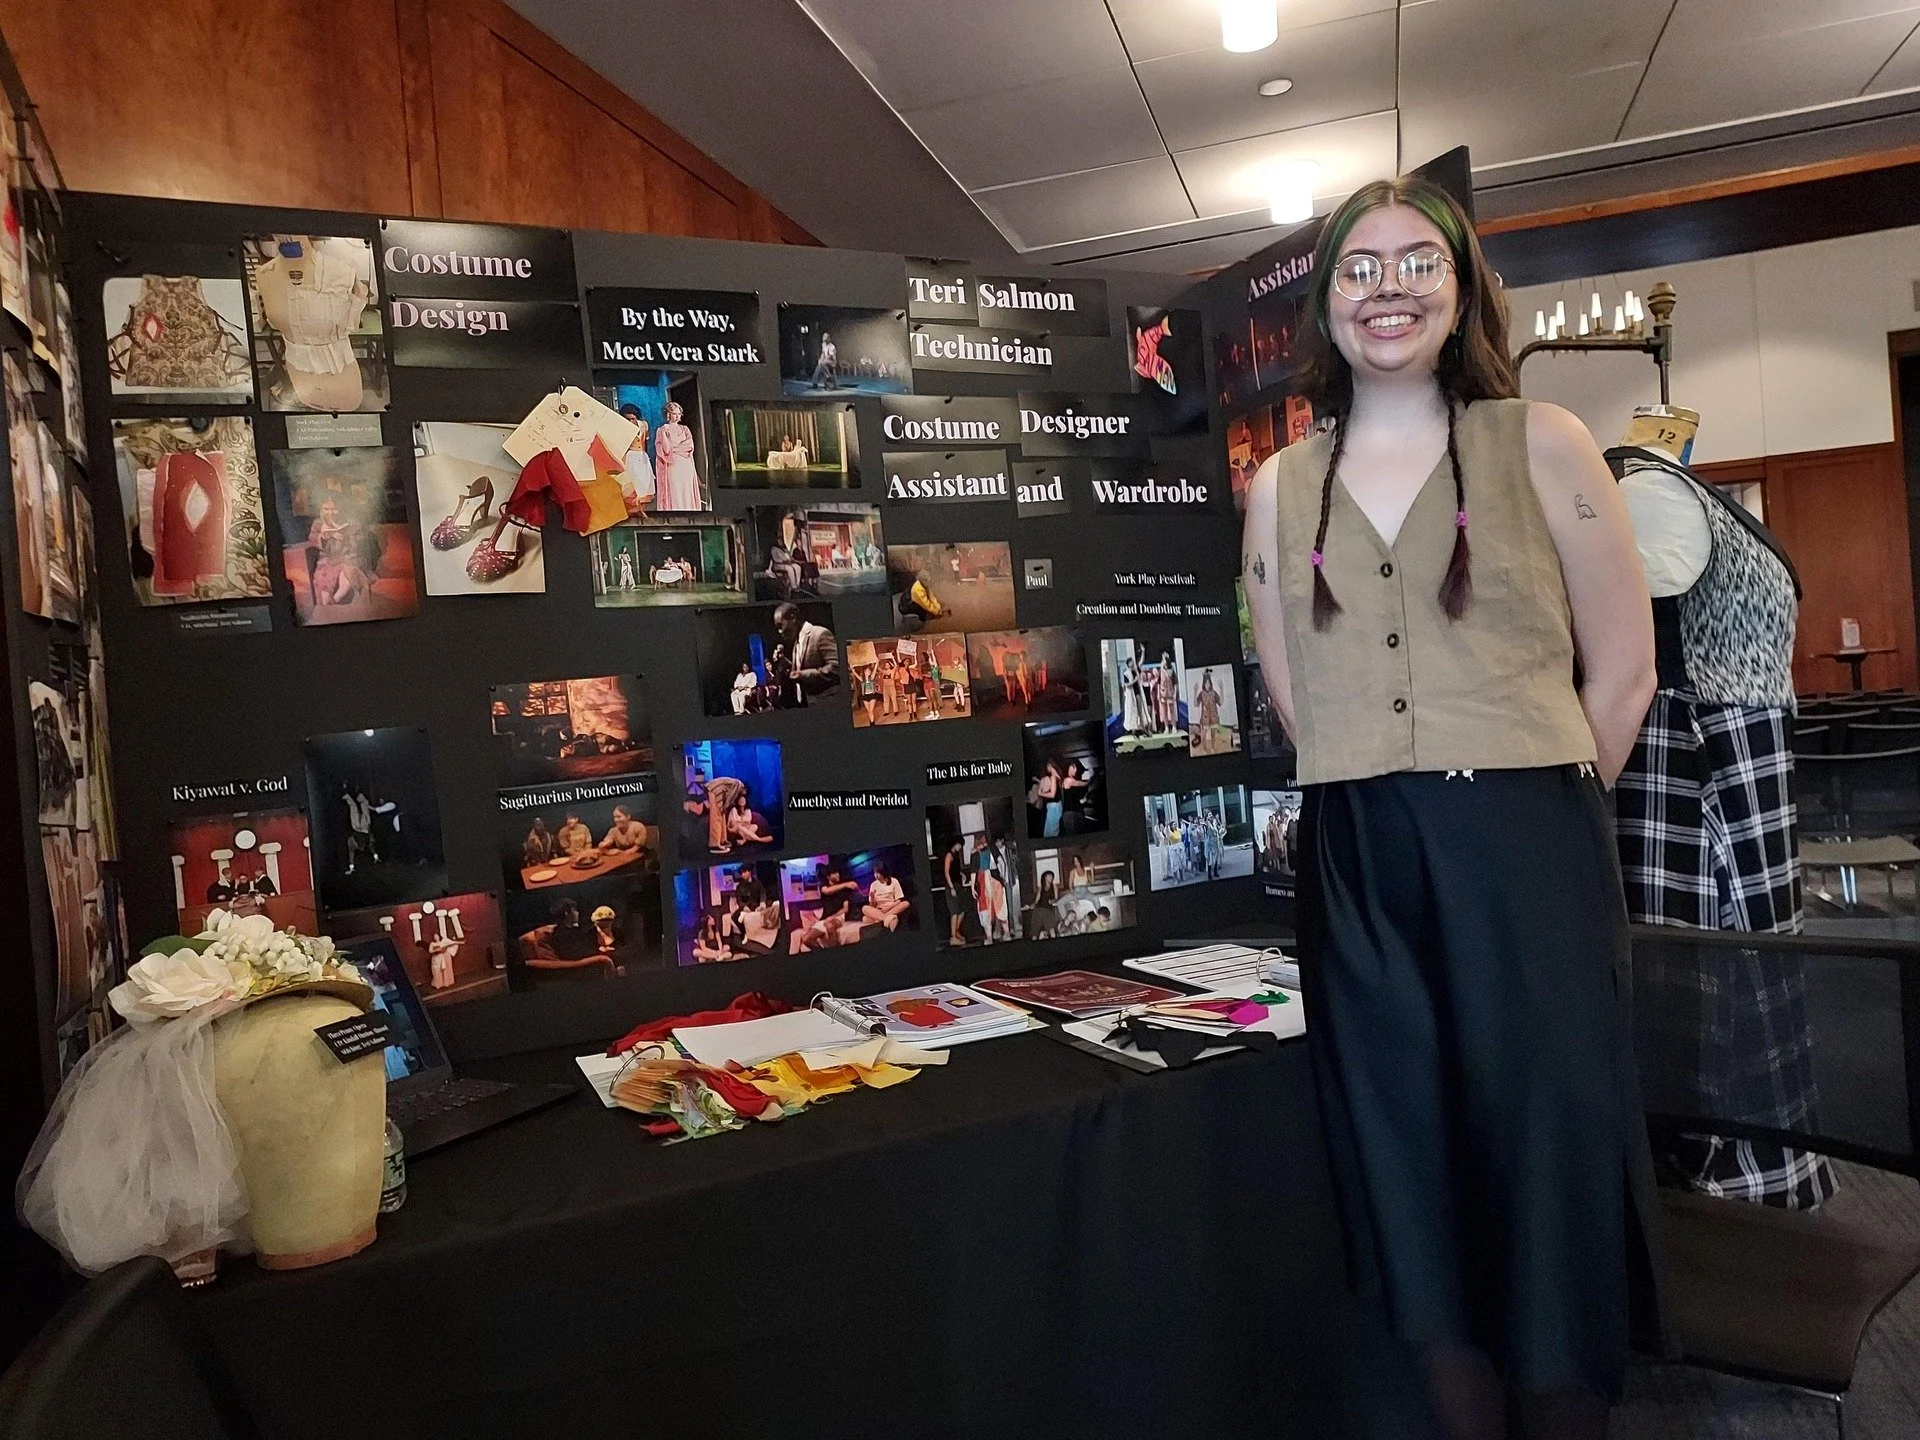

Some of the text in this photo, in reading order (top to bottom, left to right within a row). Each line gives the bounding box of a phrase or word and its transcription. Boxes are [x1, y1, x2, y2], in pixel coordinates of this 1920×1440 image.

[384, 246, 533, 279] Costume
[909, 278, 1076, 312] Teri Salmon
[391, 301, 510, 336] Design
[621, 307, 735, 333] By the Way,
[602, 341, 760, 363] Meet Vera Stark
[909, 332, 1053, 366] Technician
[883, 408, 1130, 441] Costume Designer
[1657, 428, 1677, 445] 12
[887, 471, 1208, 504] Assistant and Wardrobe
[1026, 574, 1048, 586] Paul
[1114, 573, 1136, 585] York
[1138, 573, 1156, 587] Play
[1076, 603, 1221, 616] Creation and Doubting Thomas
[926, 762, 1013, 780] The B is for Baby
[172, 776, 288, 802] Kiyawat v. God
[499, 781, 644, 810] Sagittarius Ponderosa
[789, 793, 909, 809] Amethyst and Peridot
